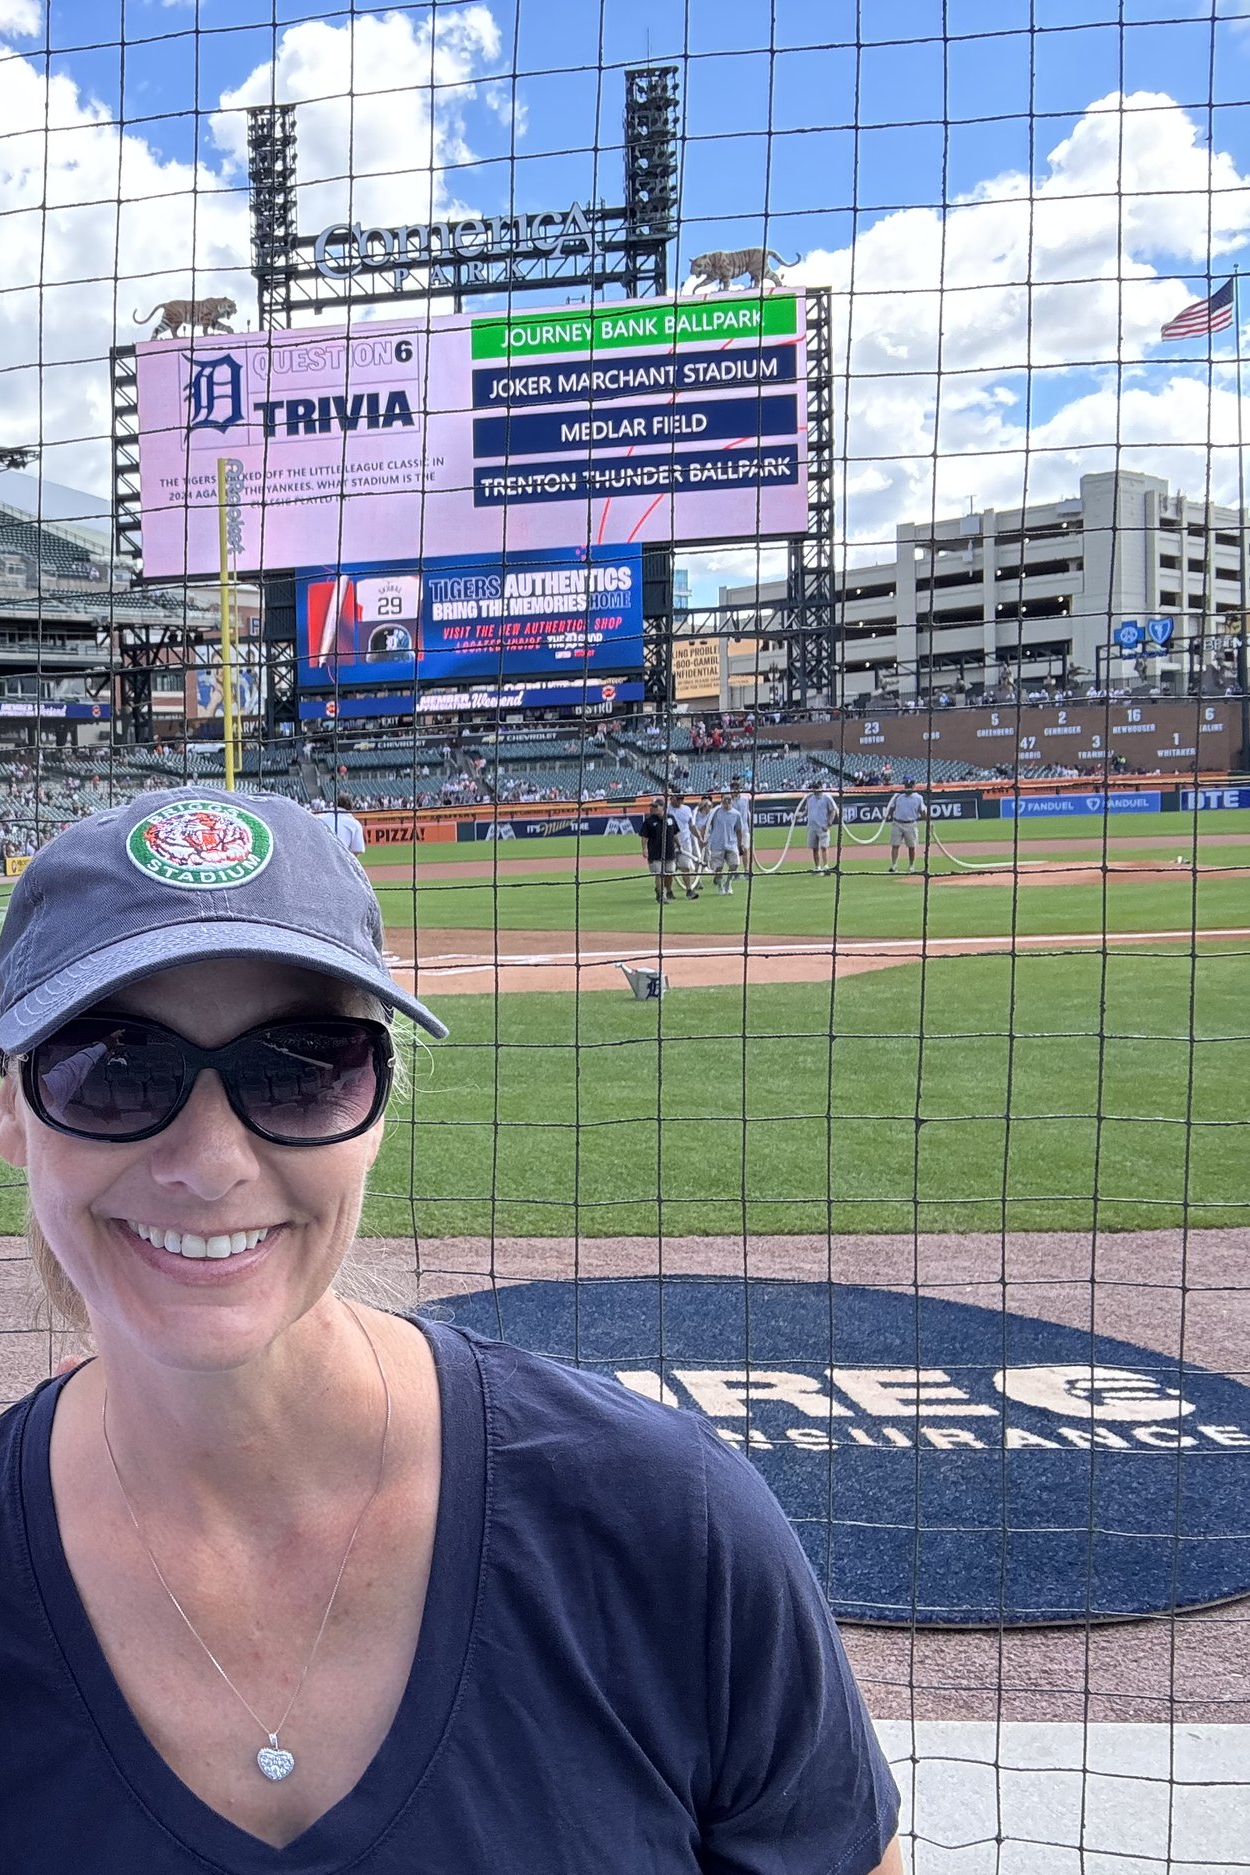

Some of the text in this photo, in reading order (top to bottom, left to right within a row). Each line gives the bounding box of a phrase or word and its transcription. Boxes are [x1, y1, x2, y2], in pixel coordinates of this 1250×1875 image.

[393, 257, 526, 289] PARK
[501, 309, 765, 348] JOURNEY BANK BALLPARK
[395, 340, 414, 363] 6
[489, 358, 778, 400] JOKER MARCHANT STADIUM
[253, 390, 415, 438] TRIVIA
[560, 413, 708, 443] MEDLAR FIELD
[159, 477, 180, 489] THE
[287, 466, 307, 479] THE
[309, 464, 341, 477] LITTLE
[344, 461, 385, 475] LEAGUE
[432, 457, 445, 468] IN
[481, 456, 791, 497] TRENTON THUNDER BALLPARK
[244, 485, 264, 497] THE
[351, 475, 399, 488] STADIUM
[402, 474, 412, 484] IS
[429, 566, 632, 602] TIGERS AUTHENTICS
[377, 596, 403, 615] 29
[432, 590, 632, 621] BRING THE MEMORIES HOME
[443, 627, 471, 639] VISIT
[475, 624, 494, 638] THE
[524, 618, 588, 634] AUTHENTIC
[594, 616, 623, 630] SHOP
[575, 702, 613, 716] BSTRO
[1058, 711, 1067, 725] 2
[1127, 708, 1141, 723] 16
[1205, 707, 1215, 721] 6
[381, 716, 399, 727] EXIT
[864, 721, 880, 735] 23
[991, 713, 999, 727] 5
[506, 732, 558, 742] CHEVROLET
[922, 731, 941, 741] CBB
[1020, 736, 1037, 749] 47
[1092, 735, 1101, 748] 3
[1172, 732, 1180, 746] 1
[1028, 801, 1074, 812] FANDUEL
[1187, 790, 1240, 809] DTE
[148, 802, 244, 825] BRIGGS
[759, 811, 808, 825] BETM
[375, 826, 426, 844] PIZZA!
[146, 853, 262, 883] STADIUM
